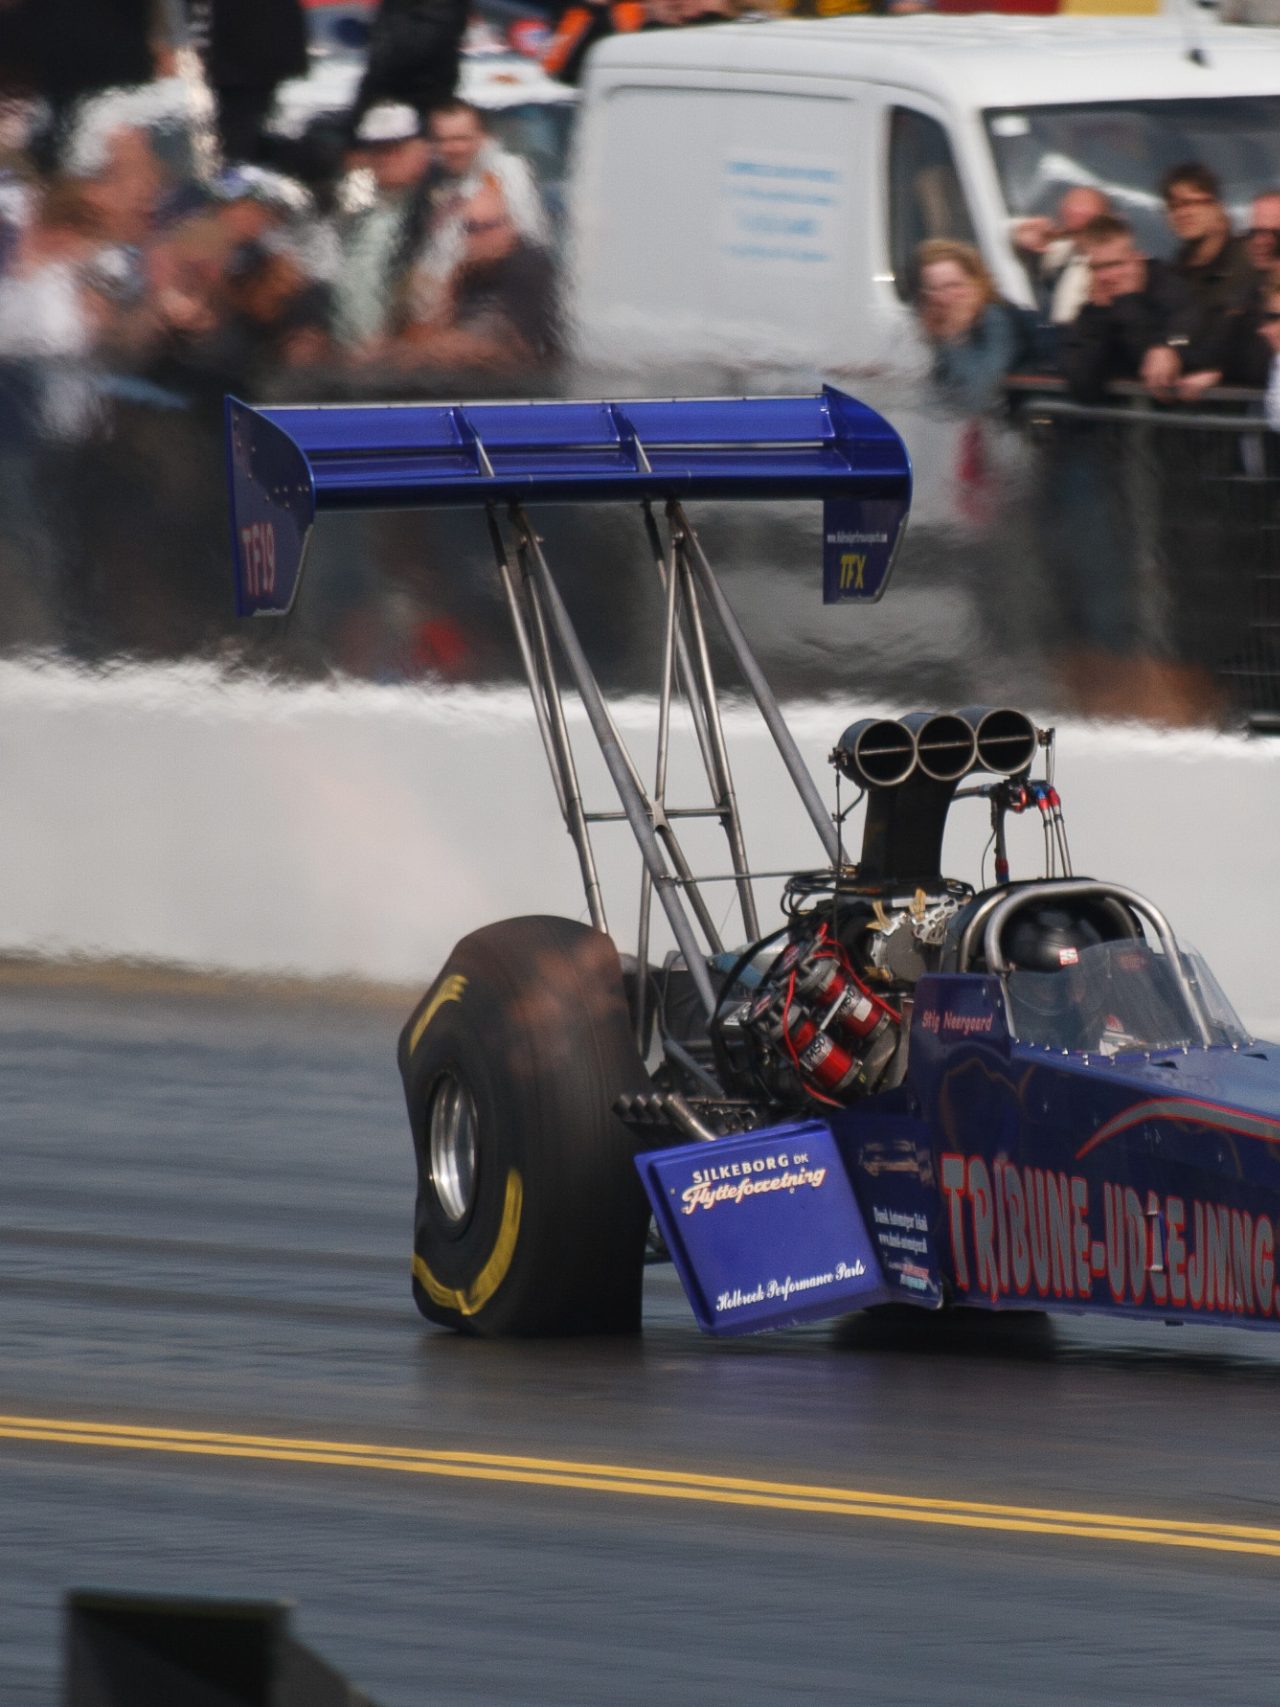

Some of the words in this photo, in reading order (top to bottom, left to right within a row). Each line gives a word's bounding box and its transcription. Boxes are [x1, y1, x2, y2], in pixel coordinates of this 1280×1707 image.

[840, 553, 866, 590] TFX
[692, 1153, 790, 1185] SILKEBORG
[792, 1152, 809, 1165] DK
[766, 1273, 833, 1302] Performance
[835, 1258, 867, 1282] Parts
